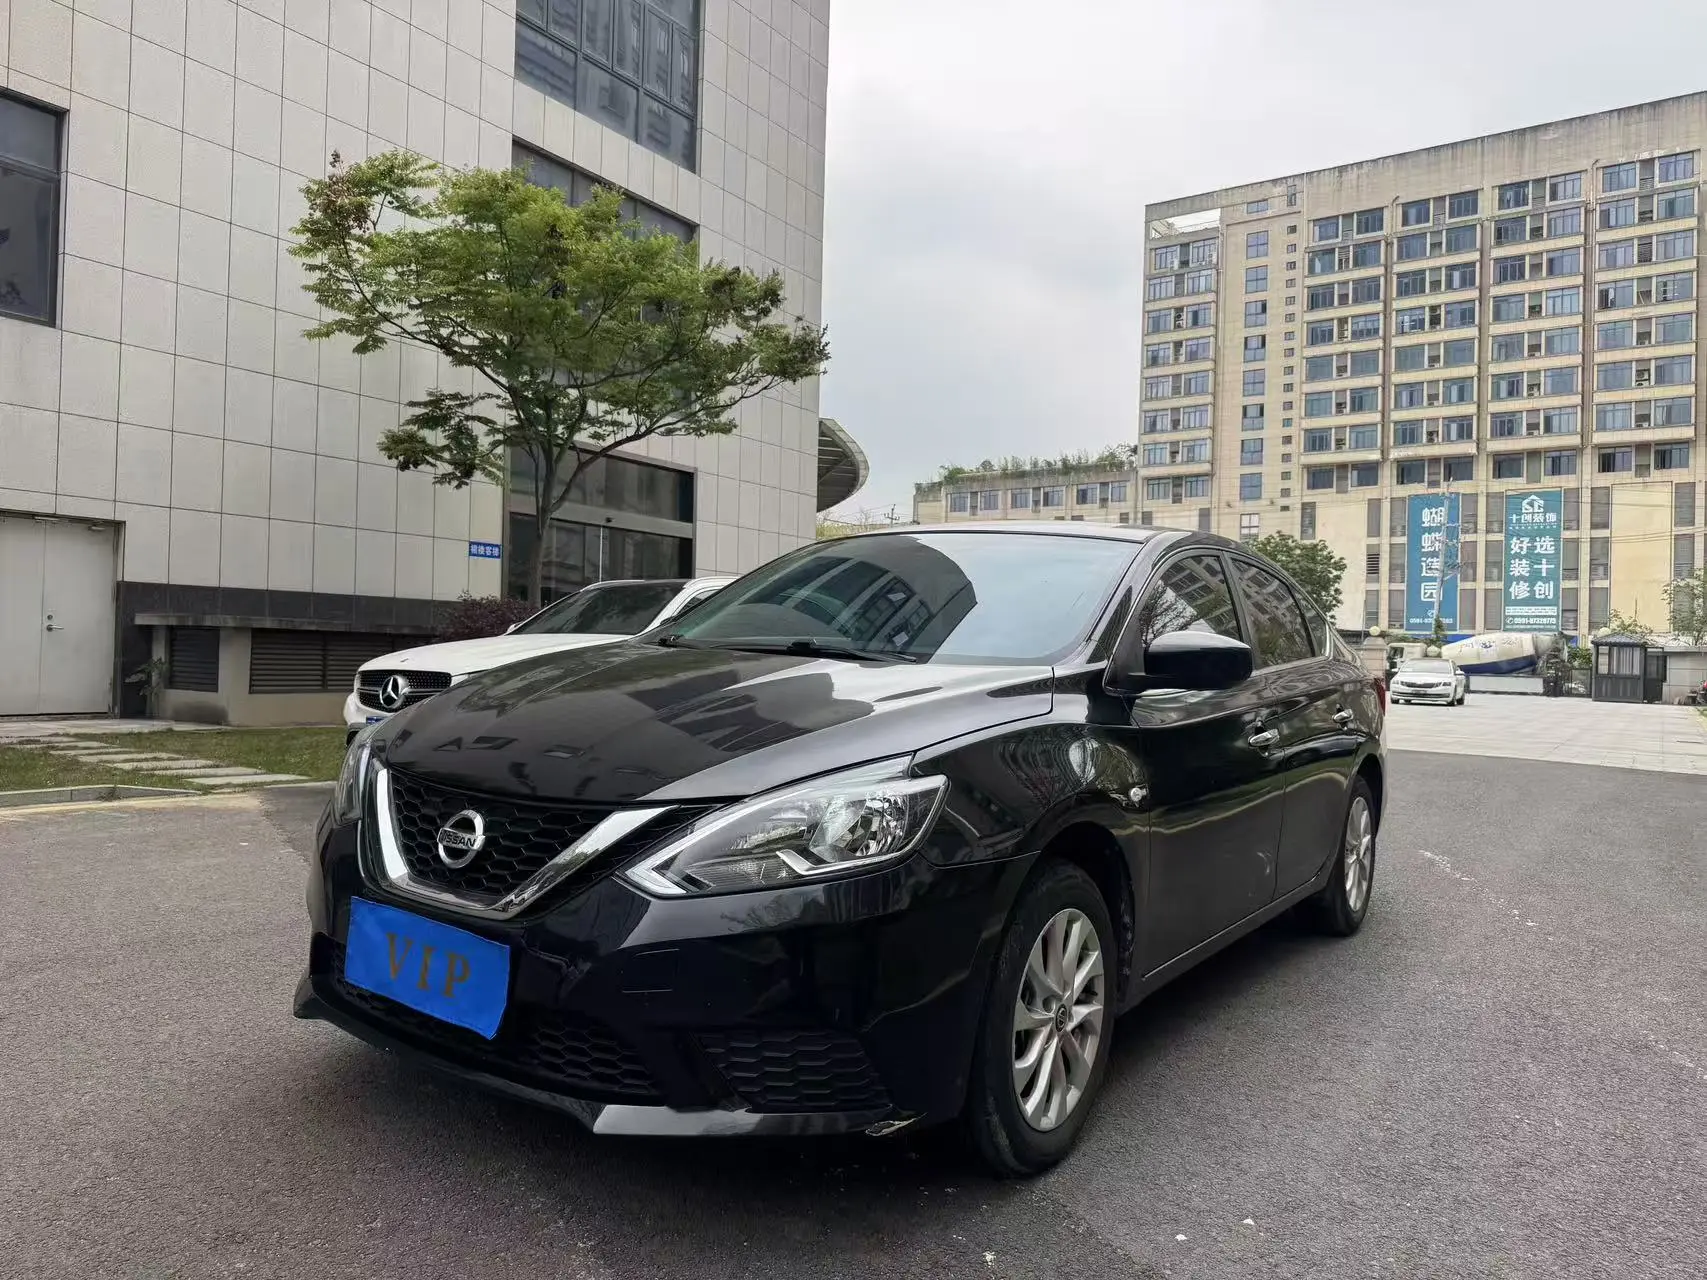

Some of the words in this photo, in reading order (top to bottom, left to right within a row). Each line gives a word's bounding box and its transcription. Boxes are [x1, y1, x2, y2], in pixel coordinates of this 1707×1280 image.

[1508, 512, 1557, 524] 十创装饰
[1509, 536, 1531, 600] 好装修
[1533, 535, 1556, 600] 选十创
[441, 830, 477, 848] NISSAN
[386, 931, 472, 999] VIP
